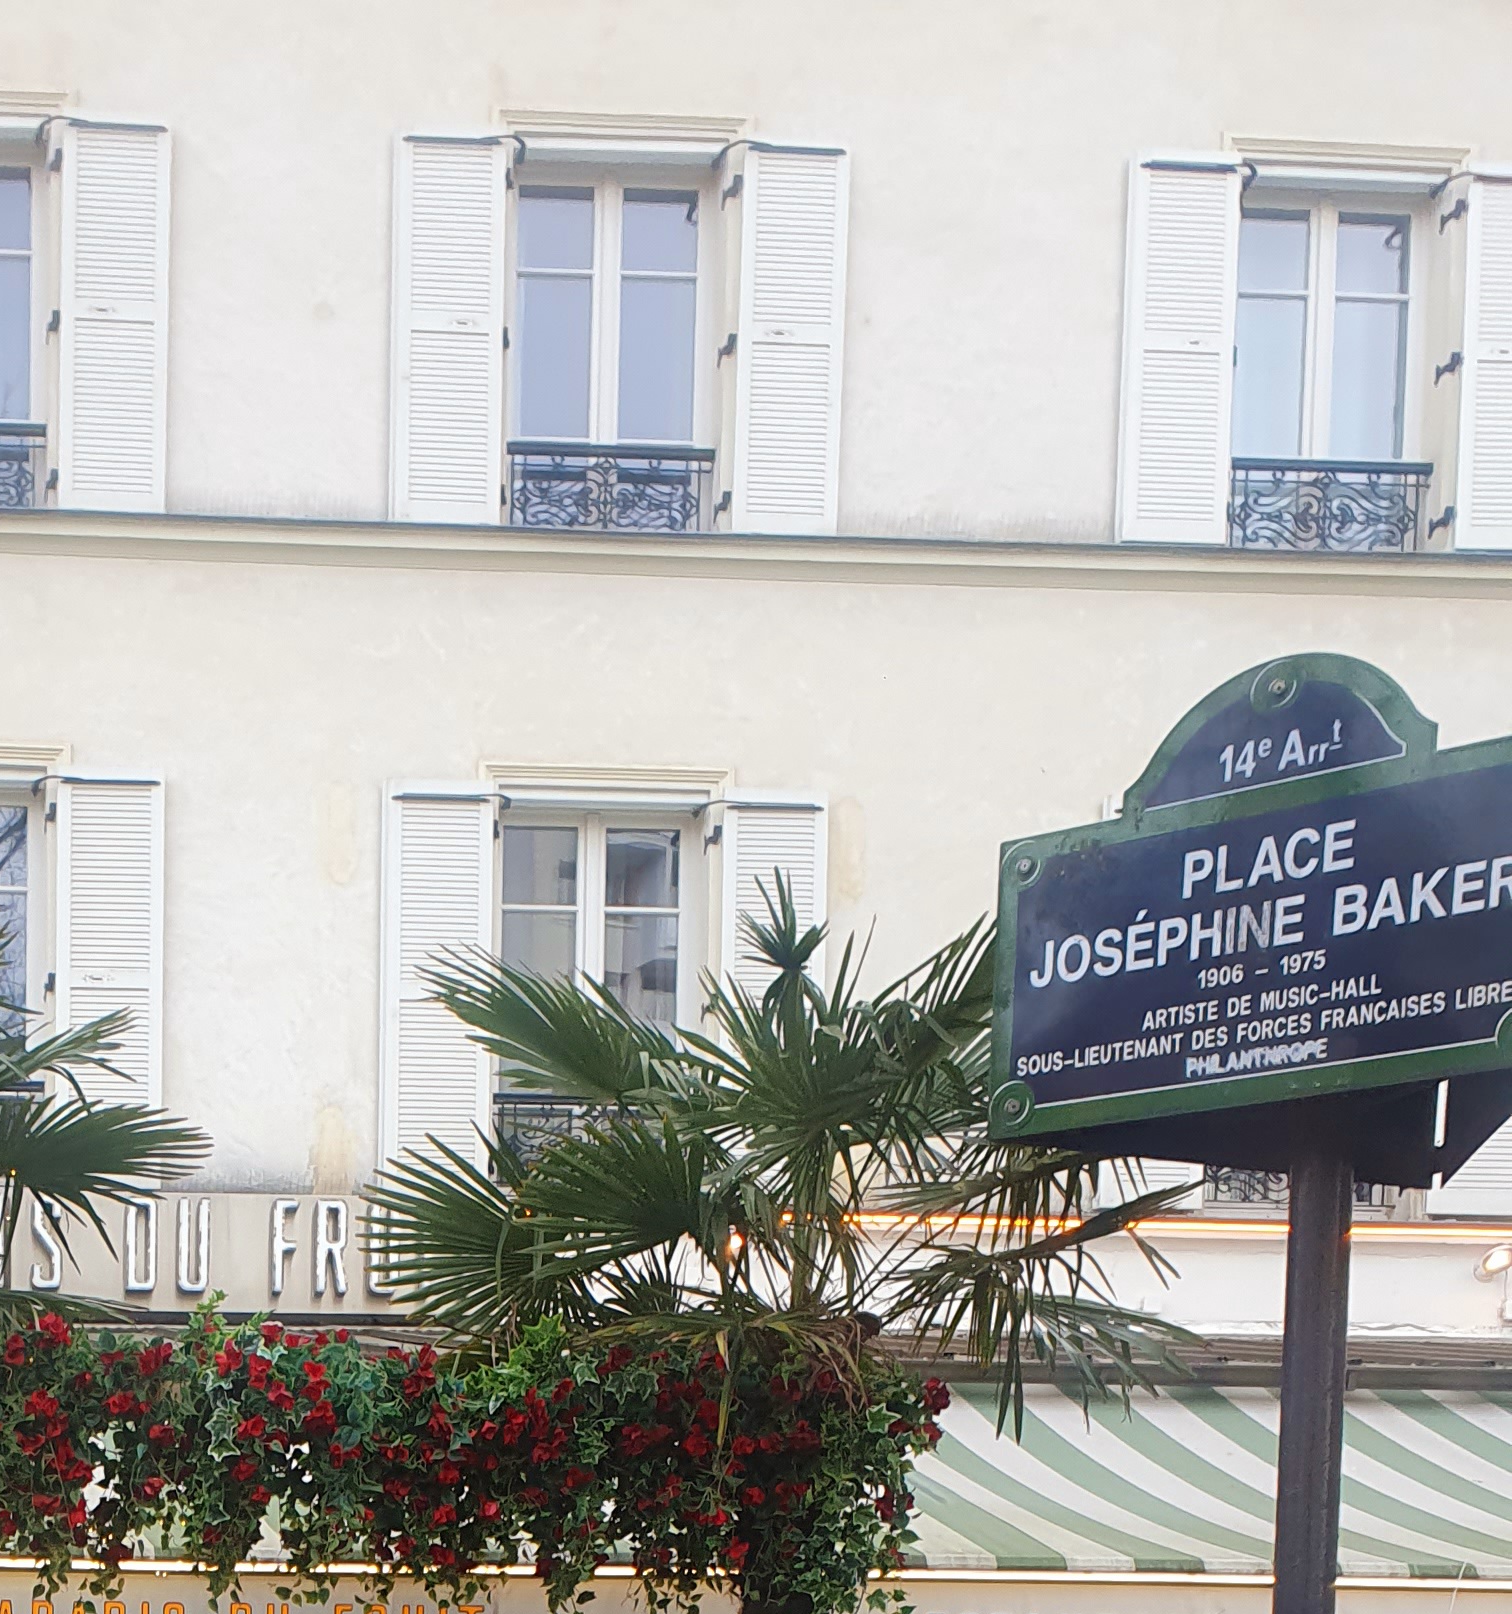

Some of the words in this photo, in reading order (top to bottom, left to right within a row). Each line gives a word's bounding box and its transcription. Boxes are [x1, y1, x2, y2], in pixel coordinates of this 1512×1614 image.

[1181, 818, 1358, 900] PLACE
[1029, 893, 1307, 989] JOSÉPHINE
[1197, 963, 1245, 990] 1906
[1279, 949, 1328, 980] 1975
[1015, 1032, 1185, 1077] SOUS-LIEUTENANT
[1191, 1026, 1230, 1052] DES
[1236, 1013, 1313, 1045] FORCES
[1320, 991, 1446, 1034] FRANÇAISES
[1140, 999, 1220, 1032] ARTISTE
[1226, 992, 1253, 1018] DE
[1259, 973, 1384, 1012] MUSIC-HALL
[1185, 1038, 1330, 1080] PHILANTHROPE
[124, 1196, 212, 1294] DU
